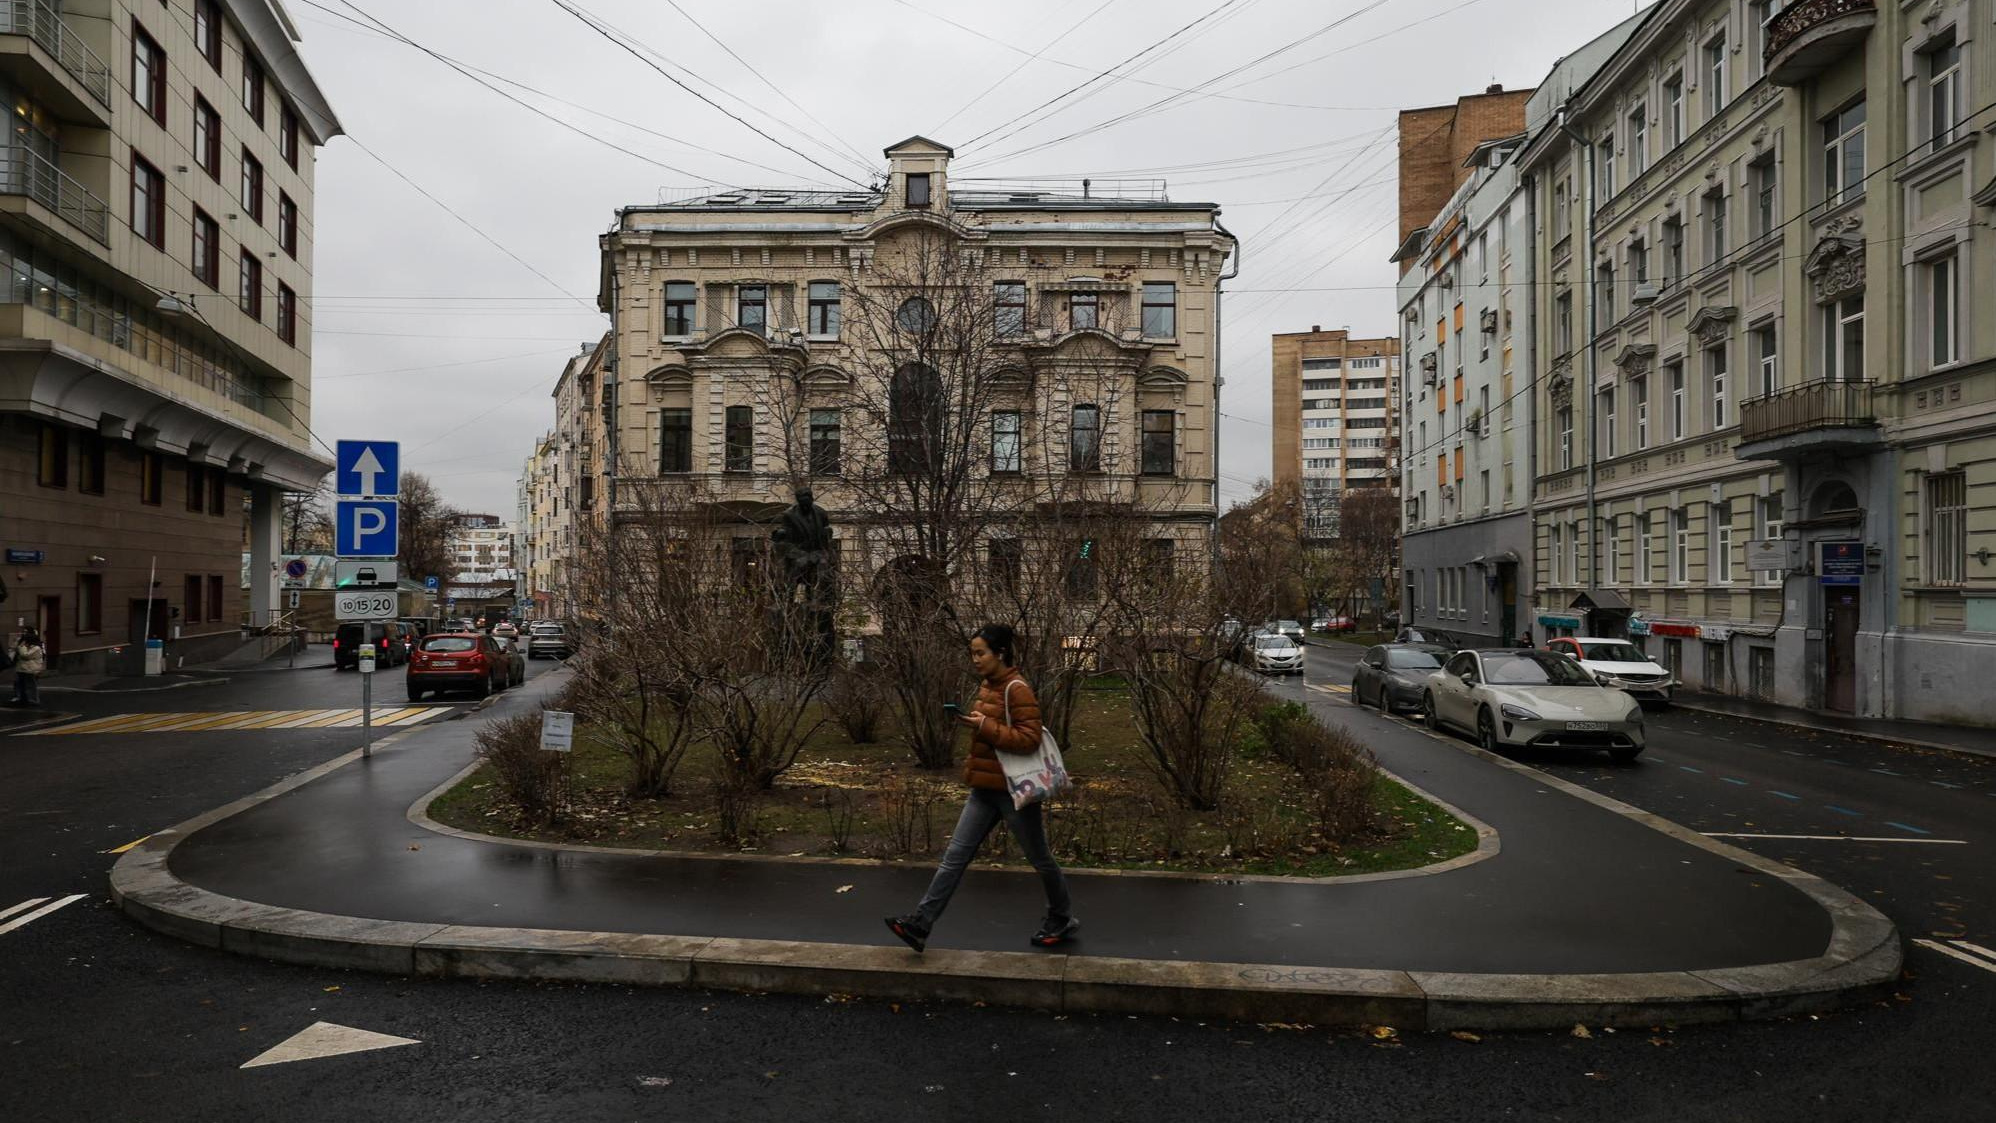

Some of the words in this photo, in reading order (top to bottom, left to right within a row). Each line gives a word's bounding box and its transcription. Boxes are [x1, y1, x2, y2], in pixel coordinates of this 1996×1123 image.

[353, 507, 386, 550] P
[428, 577, 436, 587] P
[343, 602, 353, 610] 10
[357, 600, 368, 610] 15
[373, 599, 391, 611] 20
